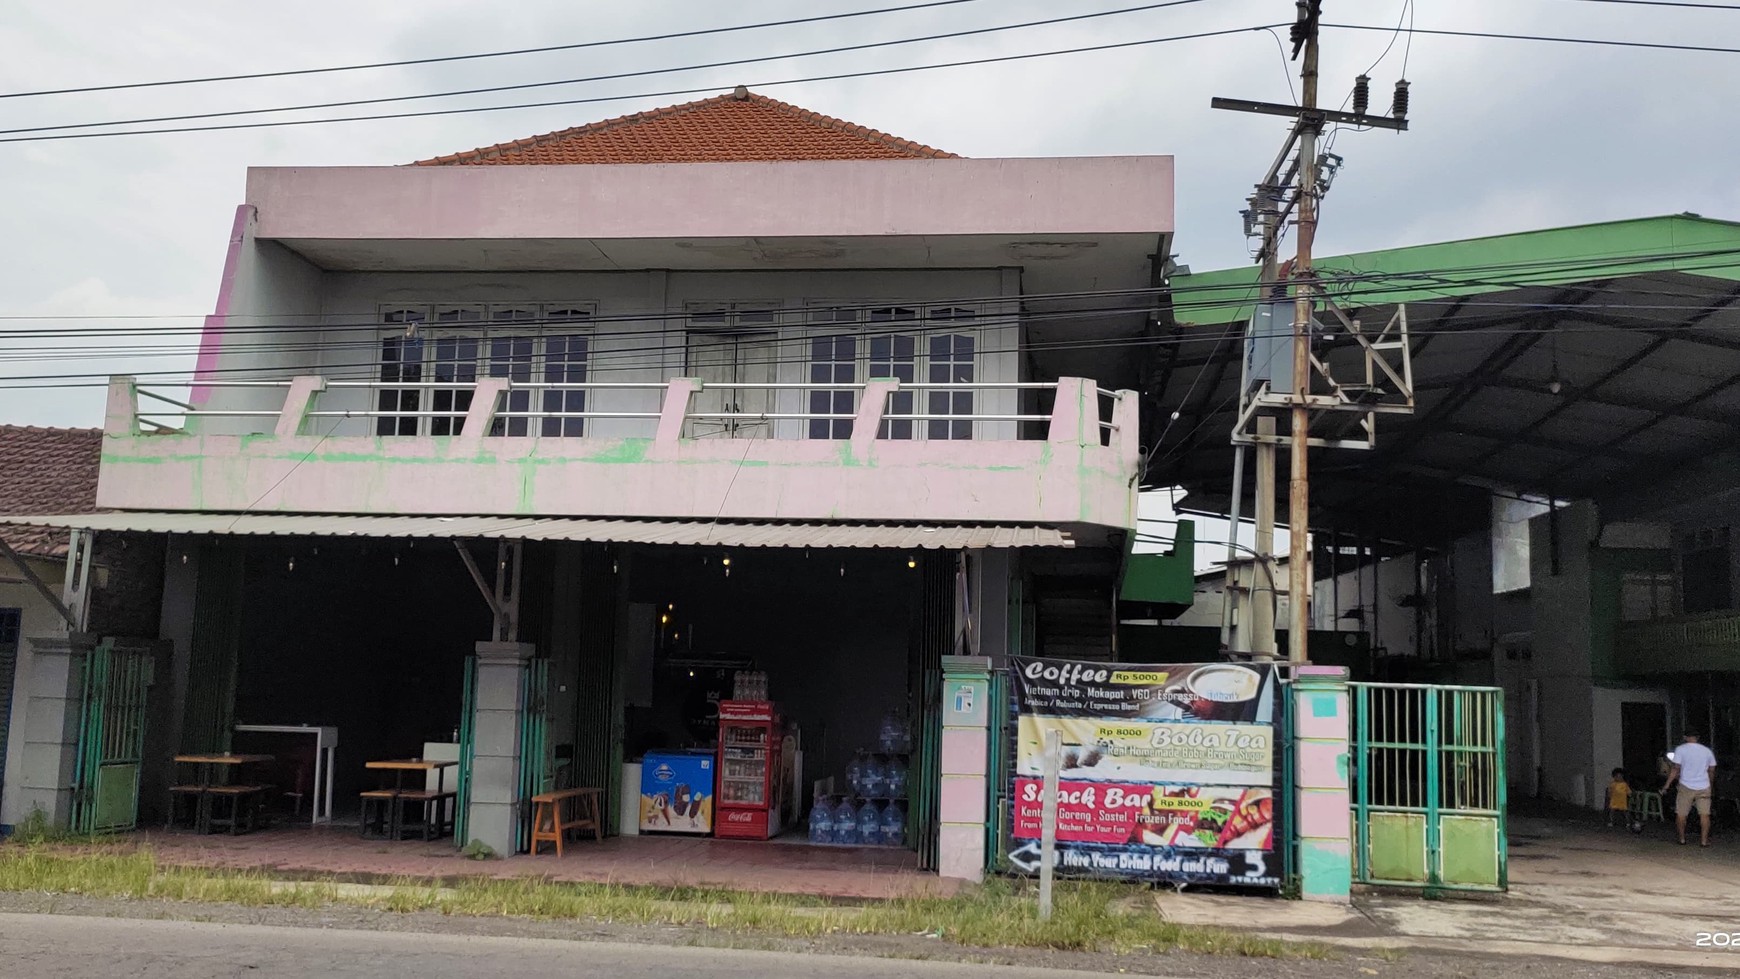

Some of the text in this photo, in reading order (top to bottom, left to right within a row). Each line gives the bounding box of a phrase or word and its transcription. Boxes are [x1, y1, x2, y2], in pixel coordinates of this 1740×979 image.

[1025, 662, 1108, 685] Coffee
[1024, 684, 1060, 697] Vietnam
[1062, 686, 1080, 698] drip
[1087, 687, 1124, 699] Mokapot
[1132, 689, 1150, 700] V60
[1158, 689, 1199, 701] Espresso
[1024, 698, 1140, 711] Arabica Robusta Espresso Blend
[1100, 728, 1142, 737] Rp 8000
[1151, 727, 1266, 749] Boba Tea
[1107, 744, 1127, 756] Real
[1130, 746, 1179, 758] Homemade
[1207, 748, 1236, 760] Brown
[1239, 749, 1265, 763] Sugar
[1104, 788, 1150, 808] Bar
[1160, 799, 1204, 808] Rp 8000
[1059, 808, 1091, 823] Goreng
[1135, 812, 1166, 825] Frozen
[1020, 820, 1038, 830] From
[1058, 822, 1083, 832] Kitchen
[1084, 824, 1094, 832] for
[1096, 825, 1112, 833] Your
[1113, 825, 1126, 833] Fun
[1063, 849, 1229, 874] Here Your Drink Food and Fun
